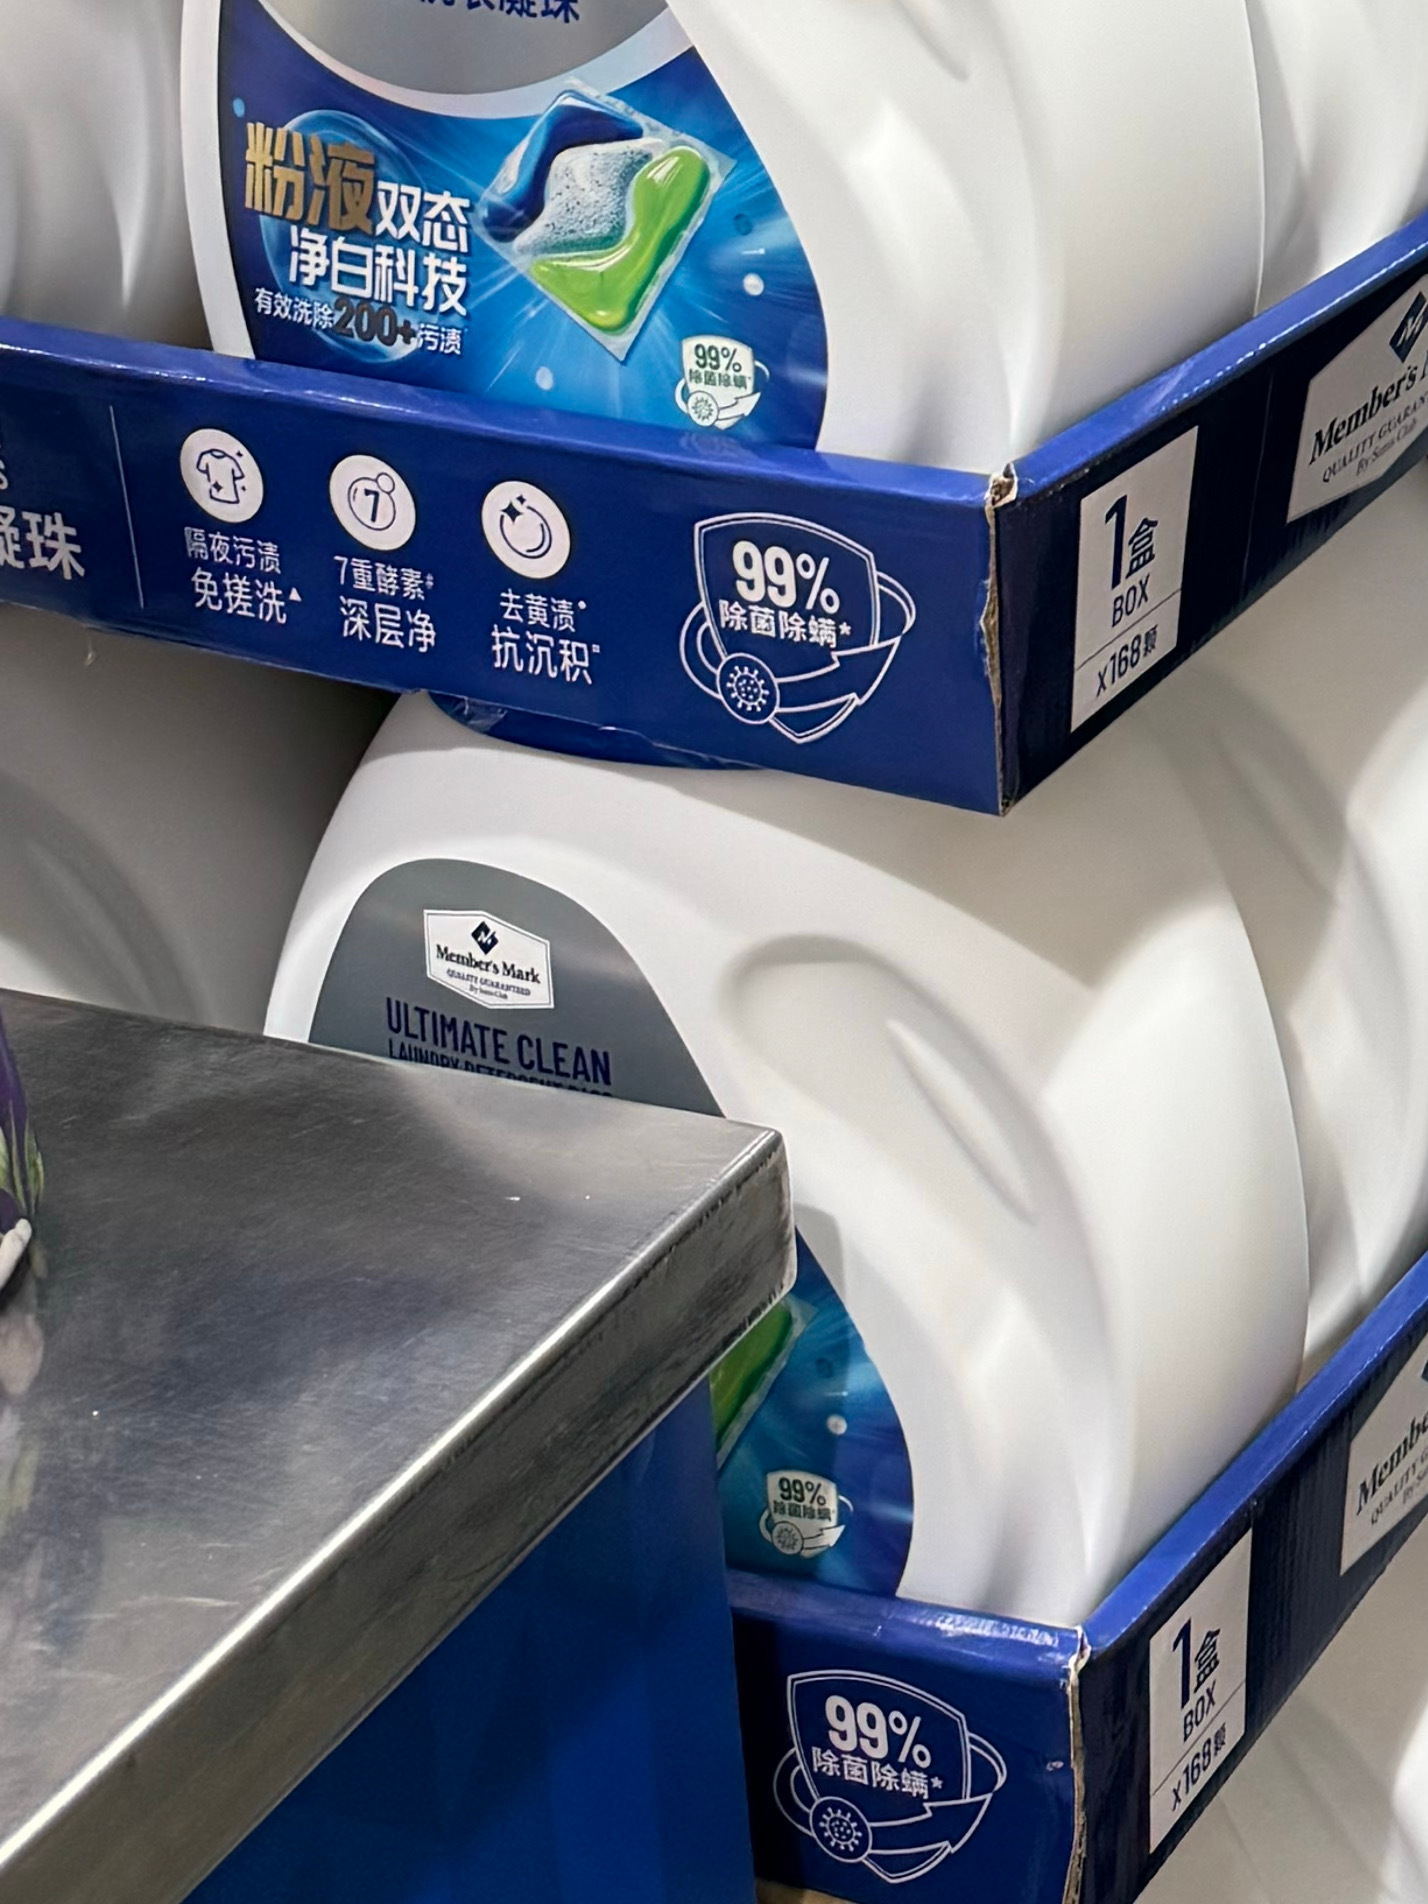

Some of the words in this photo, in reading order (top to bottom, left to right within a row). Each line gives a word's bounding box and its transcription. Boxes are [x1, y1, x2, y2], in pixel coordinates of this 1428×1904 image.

[244, 120, 471, 254] 粉液双态
[289, 224, 468, 319] 净白科技
[692, 341, 743, 374] 99%
[1309, 366, 1418, 466] Member's
[1322, 432, 1377, 484] QUALITY
[184, 525, 282, 575] 隔夜污渍
[1105, 494, 1159, 590] 1盒
[190, 568, 288, 625] 免搓洗
[730, 539, 841, 618] 99%
[1111, 573, 1150, 628] BOX
[339, 596, 437, 653] 深层净
[499, 590, 577, 634] 去黄渍
[490, 625, 594, 686] 抗沉积
[436, 944, 500, 975] Member's
[501, 961, 542, 985] Mark
[386, 996, 510, 1065] ULTIMATE
[517, 1034, 612, 1087] CLEAN
[779, 1476, 828, 1507] 99%
[1172, 1616, 1221, 1711] 1盒
[825, 1694, 932, 1770] 99%
[1183, 1679, 1217, 1744] BOX
